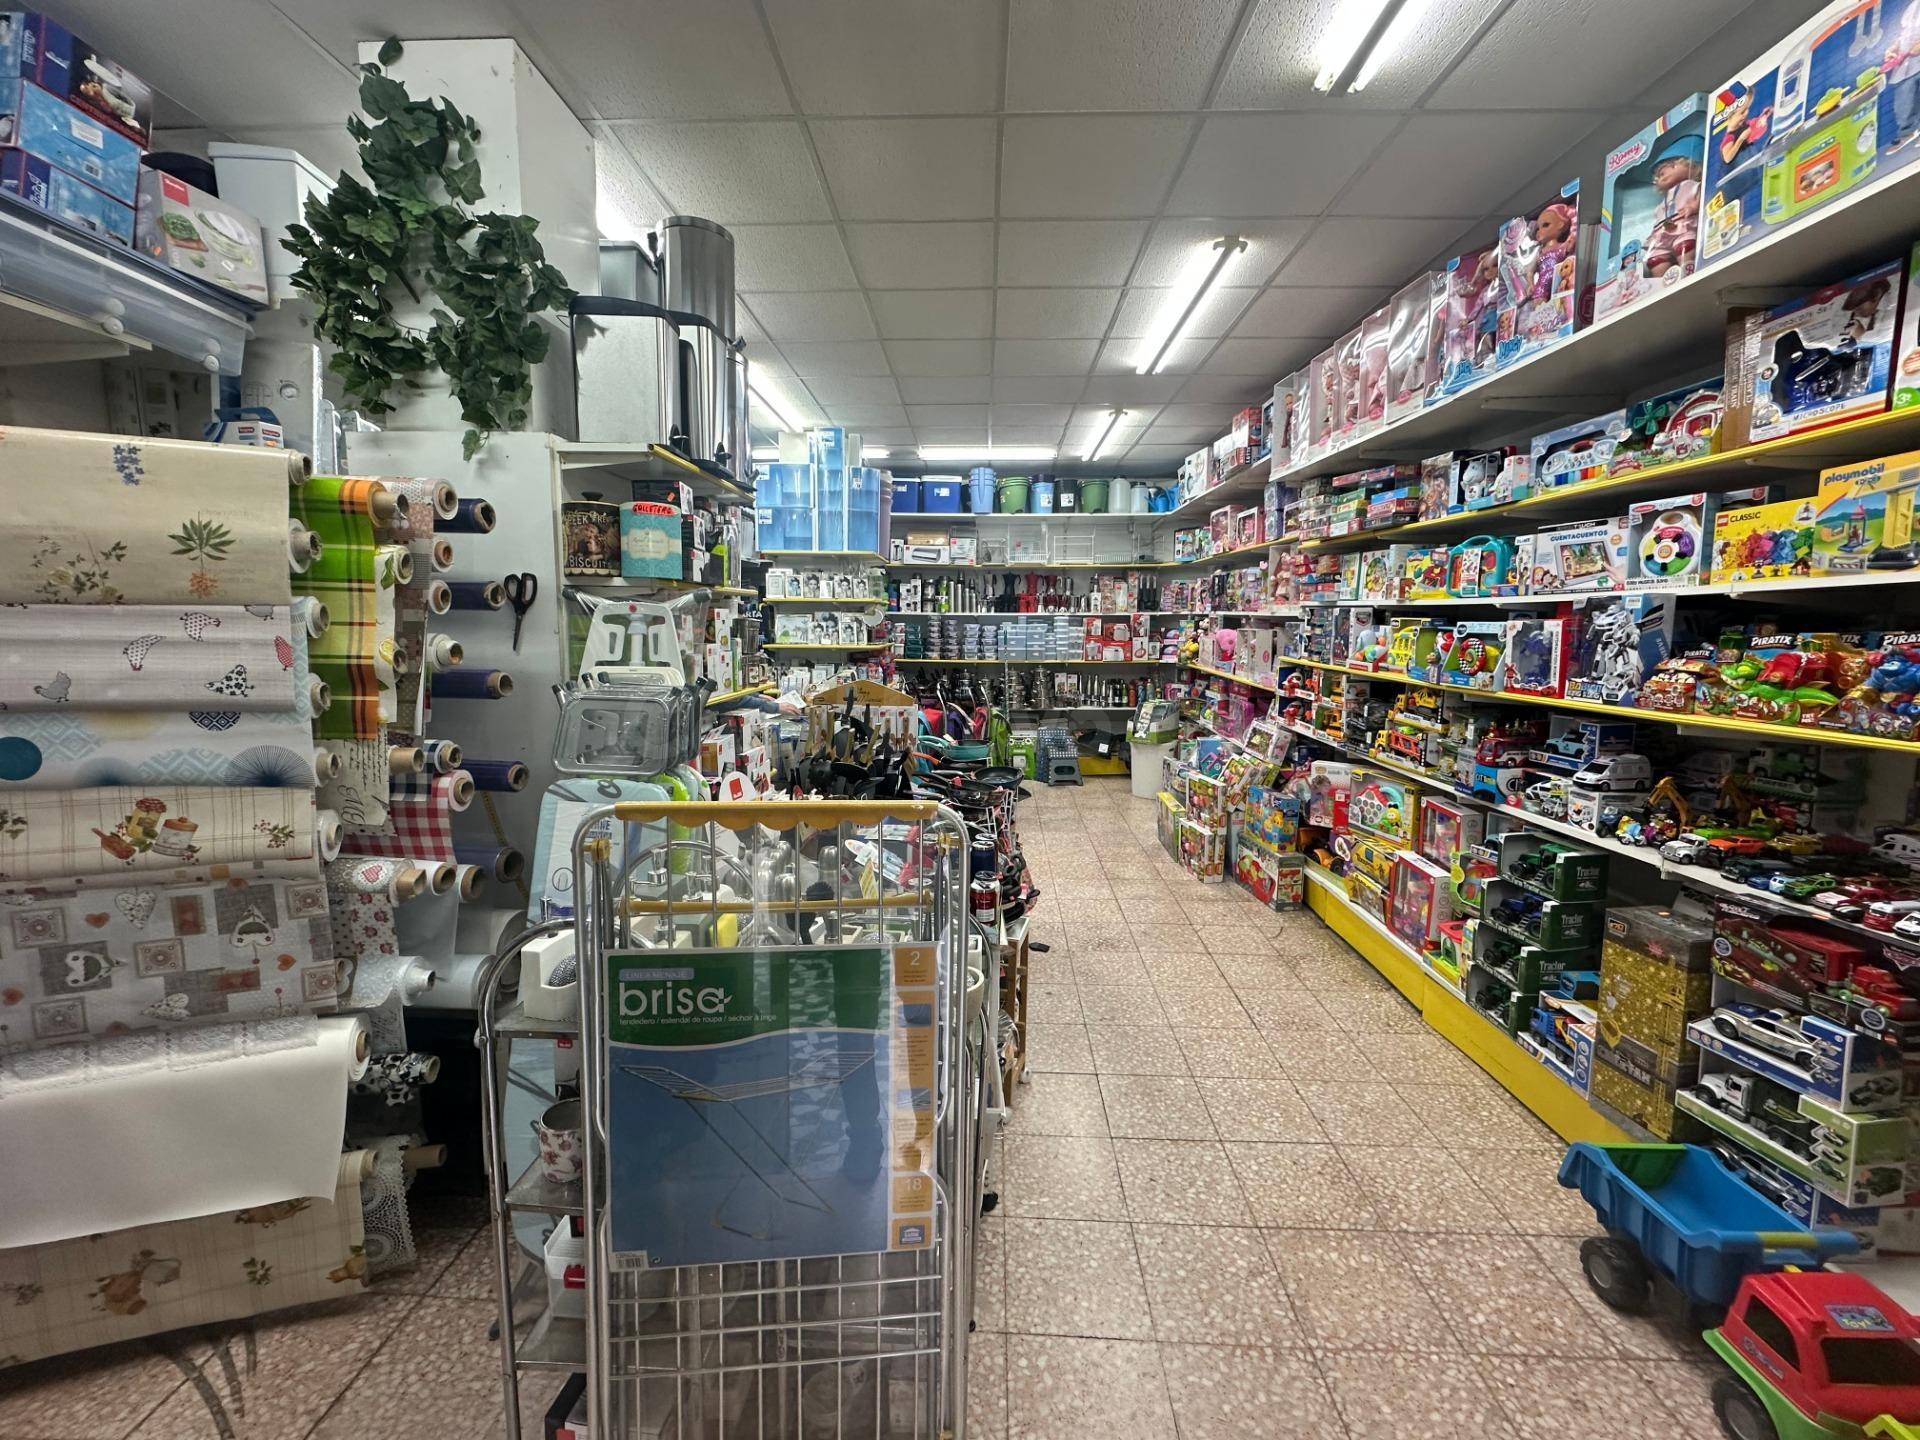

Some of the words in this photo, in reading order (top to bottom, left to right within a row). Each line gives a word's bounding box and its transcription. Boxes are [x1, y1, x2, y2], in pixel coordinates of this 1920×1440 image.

[1609, 143, 1641, 167] Romy
[1793, 404, 1846, 421] MICROSCOPE
[1824, 463, 1885, 486] playmobil
[1730, 512, 1761, 522] CLASSIC
[1551, 530, 1608, 542] CUENTACUENTOS
[1751, 635, 1793, 646] PIRATIX
[1684, 650, 1710, 658] PIRATIX
[1577, 866, 1600, 876] Tractor
[1562, 914, 1584, 924] Tractor
[911, 951, 920, 966] 2
[1540, 961, 1566, 970] Tractor
[619, 981, 733, 1016] brisa
[702, 1016, 722, 1024] roupa
[904, 1178, 921, 1191] 18
